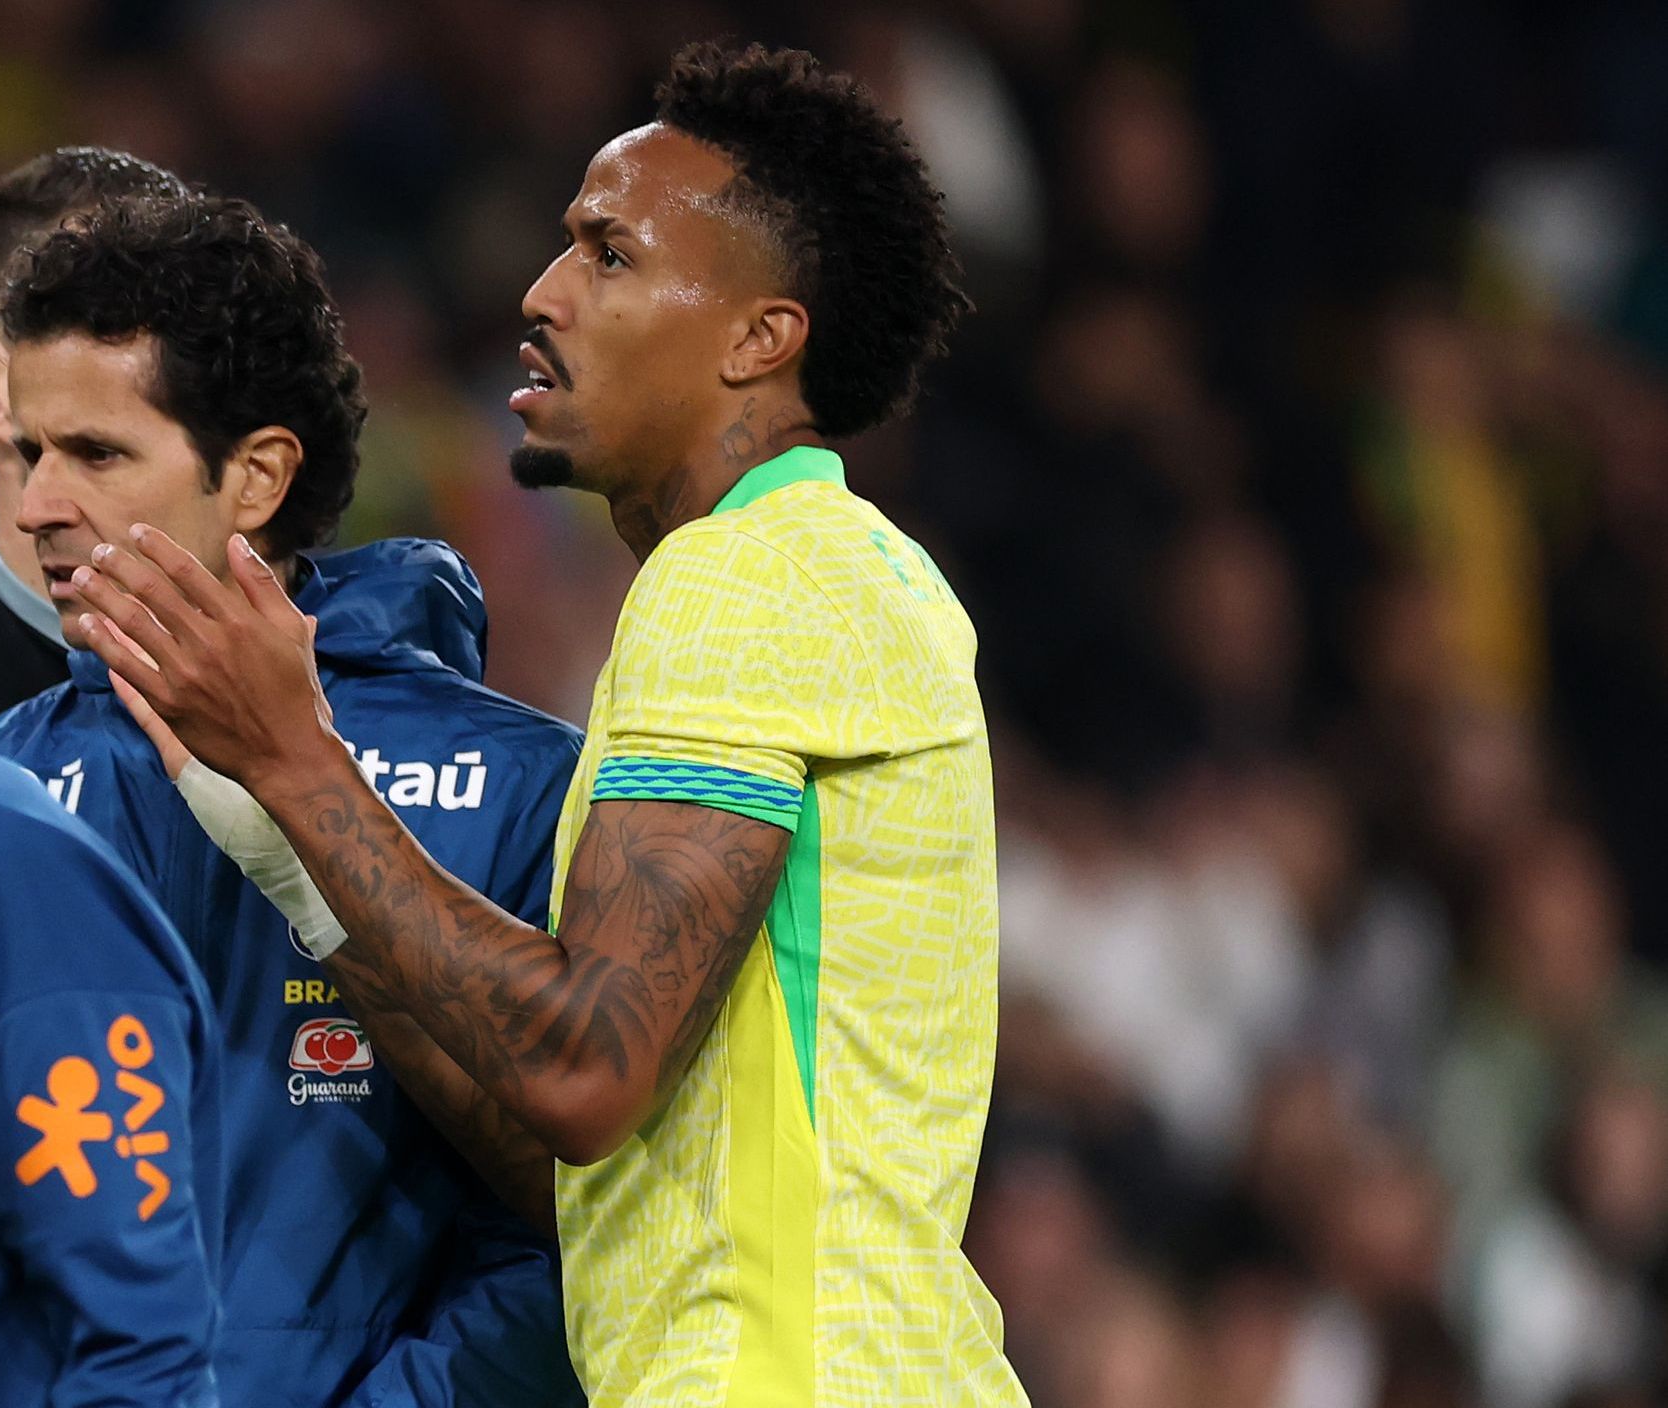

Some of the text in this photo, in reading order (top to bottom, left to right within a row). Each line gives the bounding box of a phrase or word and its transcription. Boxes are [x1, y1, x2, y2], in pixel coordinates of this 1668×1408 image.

[345, 742, 487, 811] taú
[107, 1014, 171, 1222] vivo
[287, 1072, 373, 1106] Guaraná
